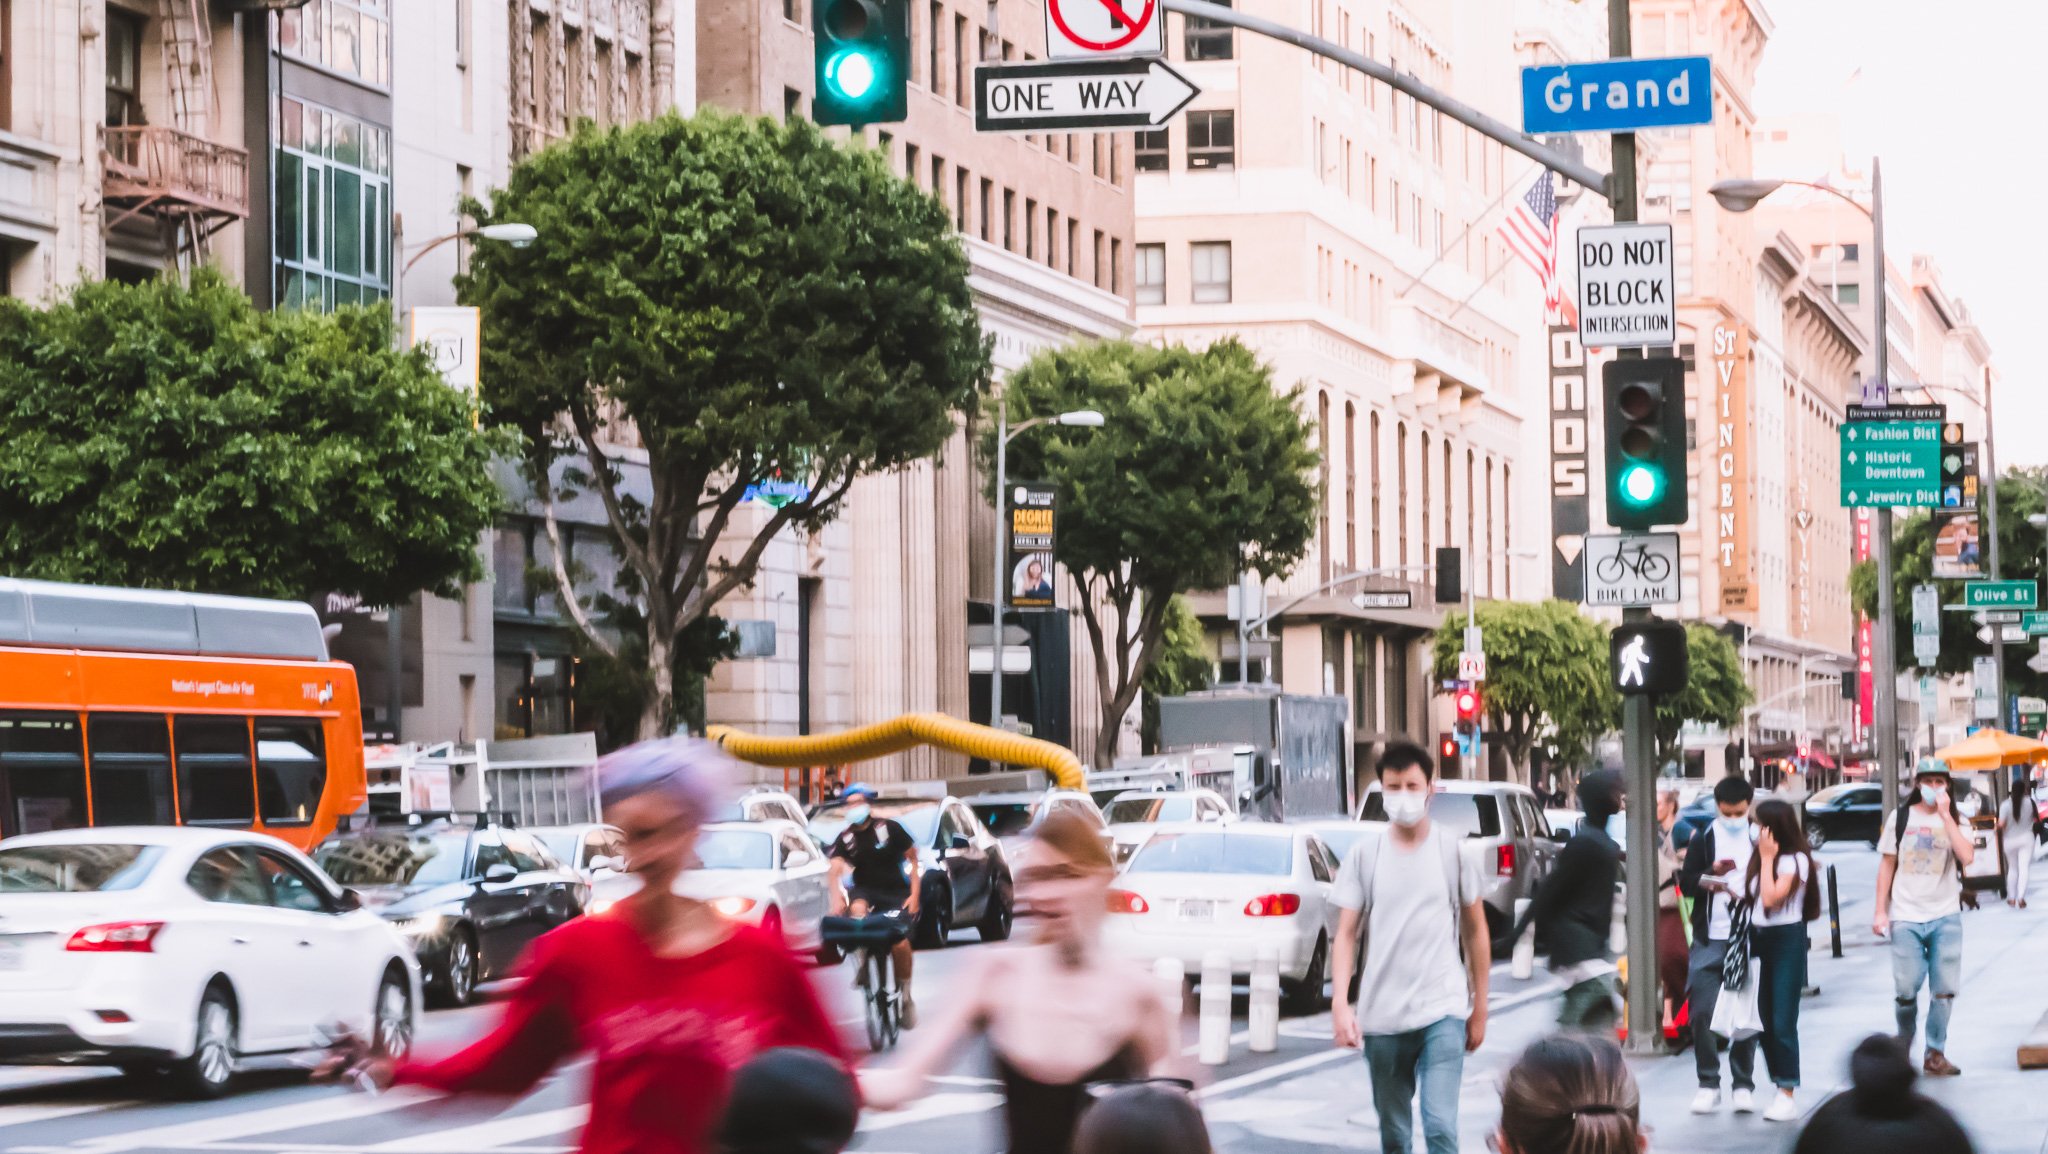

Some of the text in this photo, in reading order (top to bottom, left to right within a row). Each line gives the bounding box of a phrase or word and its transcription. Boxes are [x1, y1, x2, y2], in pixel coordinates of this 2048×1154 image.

[991, 80, 1144, 112] ONE WAY
[1544, 69, 1690, 114] Grand
[1583, 239, 1666, 267] DO NOT
[1587, 279, 1665, 306] BLOCK
[1586, 314, 1668, 333] INTERSECTION
[1714, 326, 1737, 355] ST
[1905, 408, 1941, 418] CENTER
[1865, 426, 1937, 440] Fashion Dist
[1718, 360, 1735, 567] VINCENT
[1865, 450, 1912, 464] Historic
[1865, 466, 1925, 479] Downtown
[1866, 489, 1940, 505] Jewelry Dist
[1364, 595, 1405, 607] ONE WAY
[1597, 587, 1668, 601] BIKE LANE
[1974, 588, 2029, 602] Olive St
